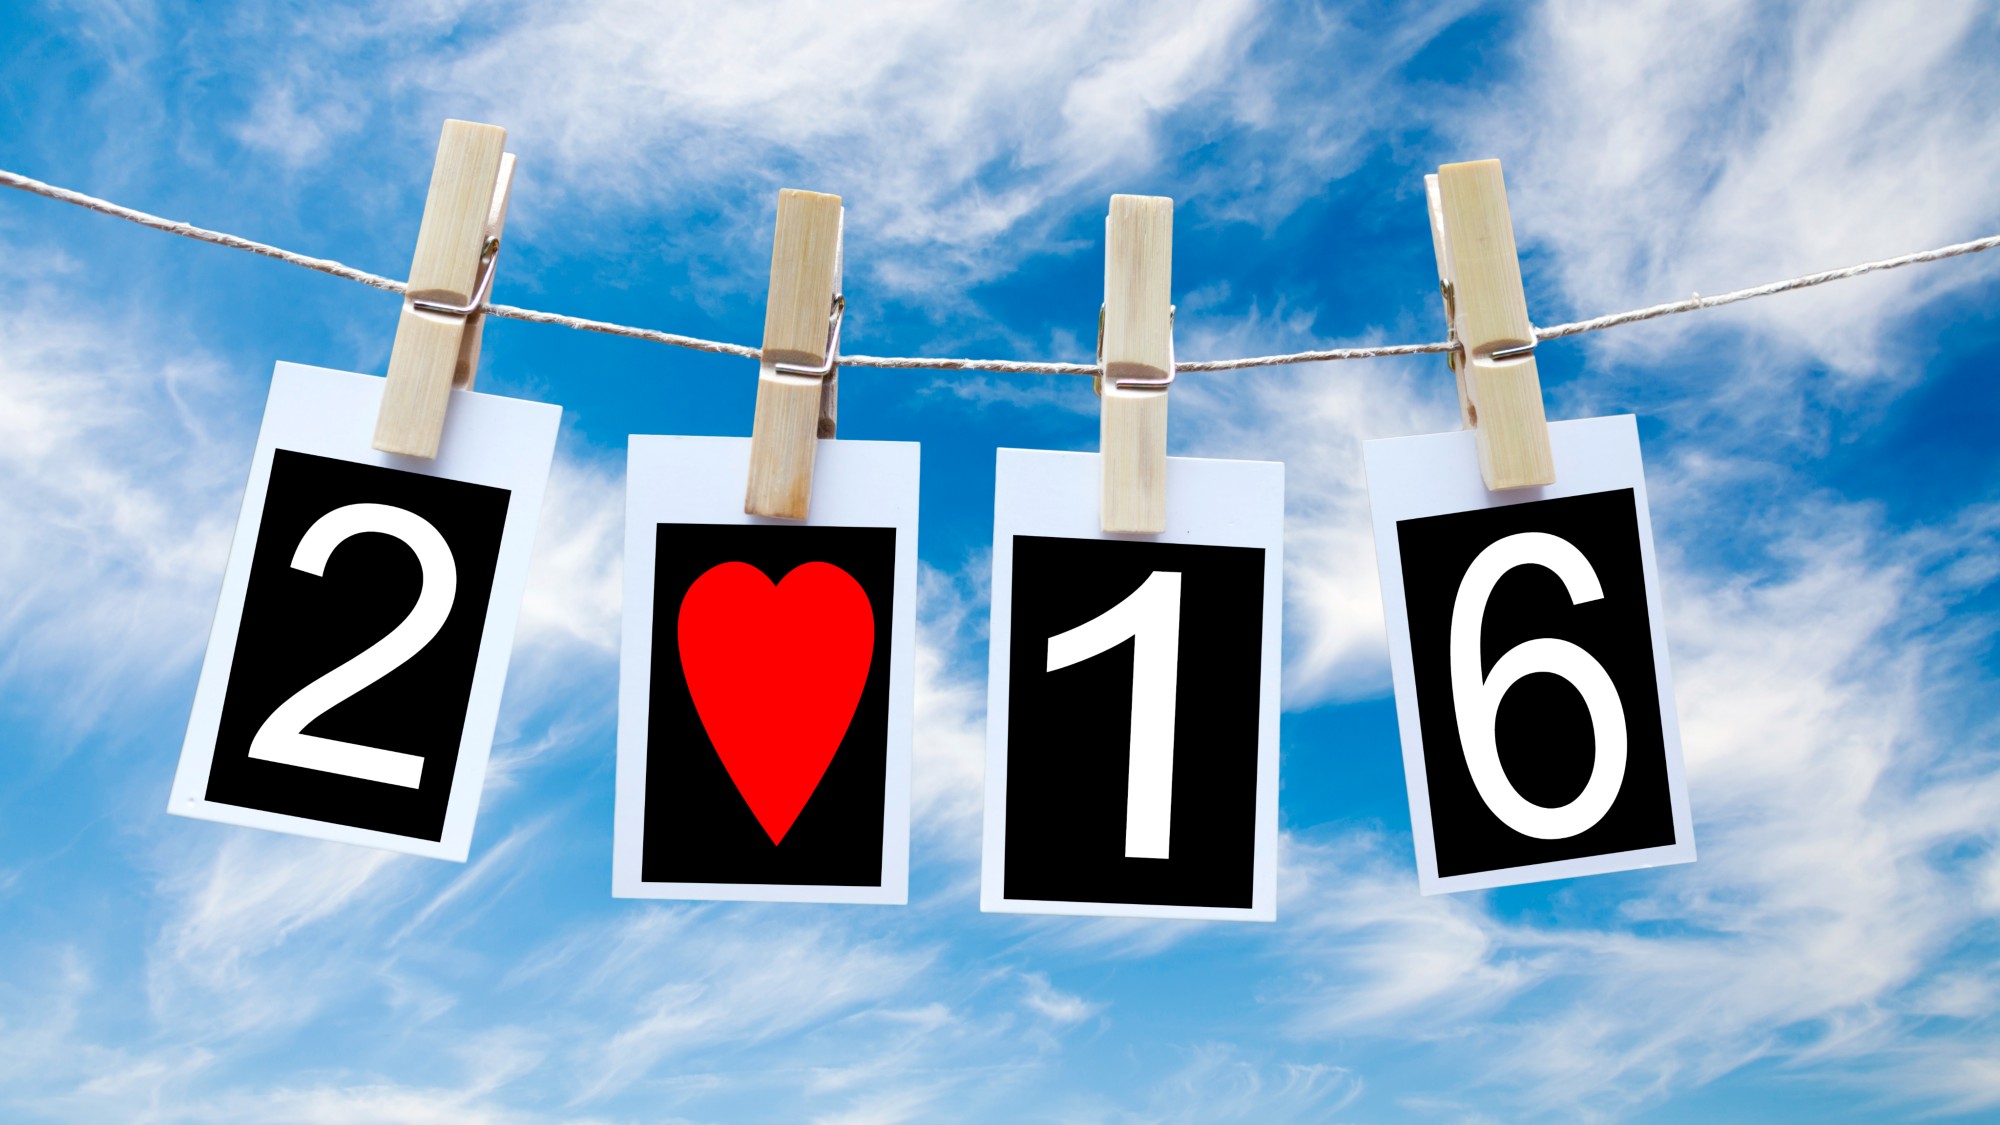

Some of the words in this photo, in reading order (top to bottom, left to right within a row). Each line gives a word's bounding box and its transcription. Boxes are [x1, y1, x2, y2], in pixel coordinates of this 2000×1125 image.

[248, 503, 457, 790] 2
[1046, 571, 1182, 860] 1
[1450, 532, 1628, 840] 6
